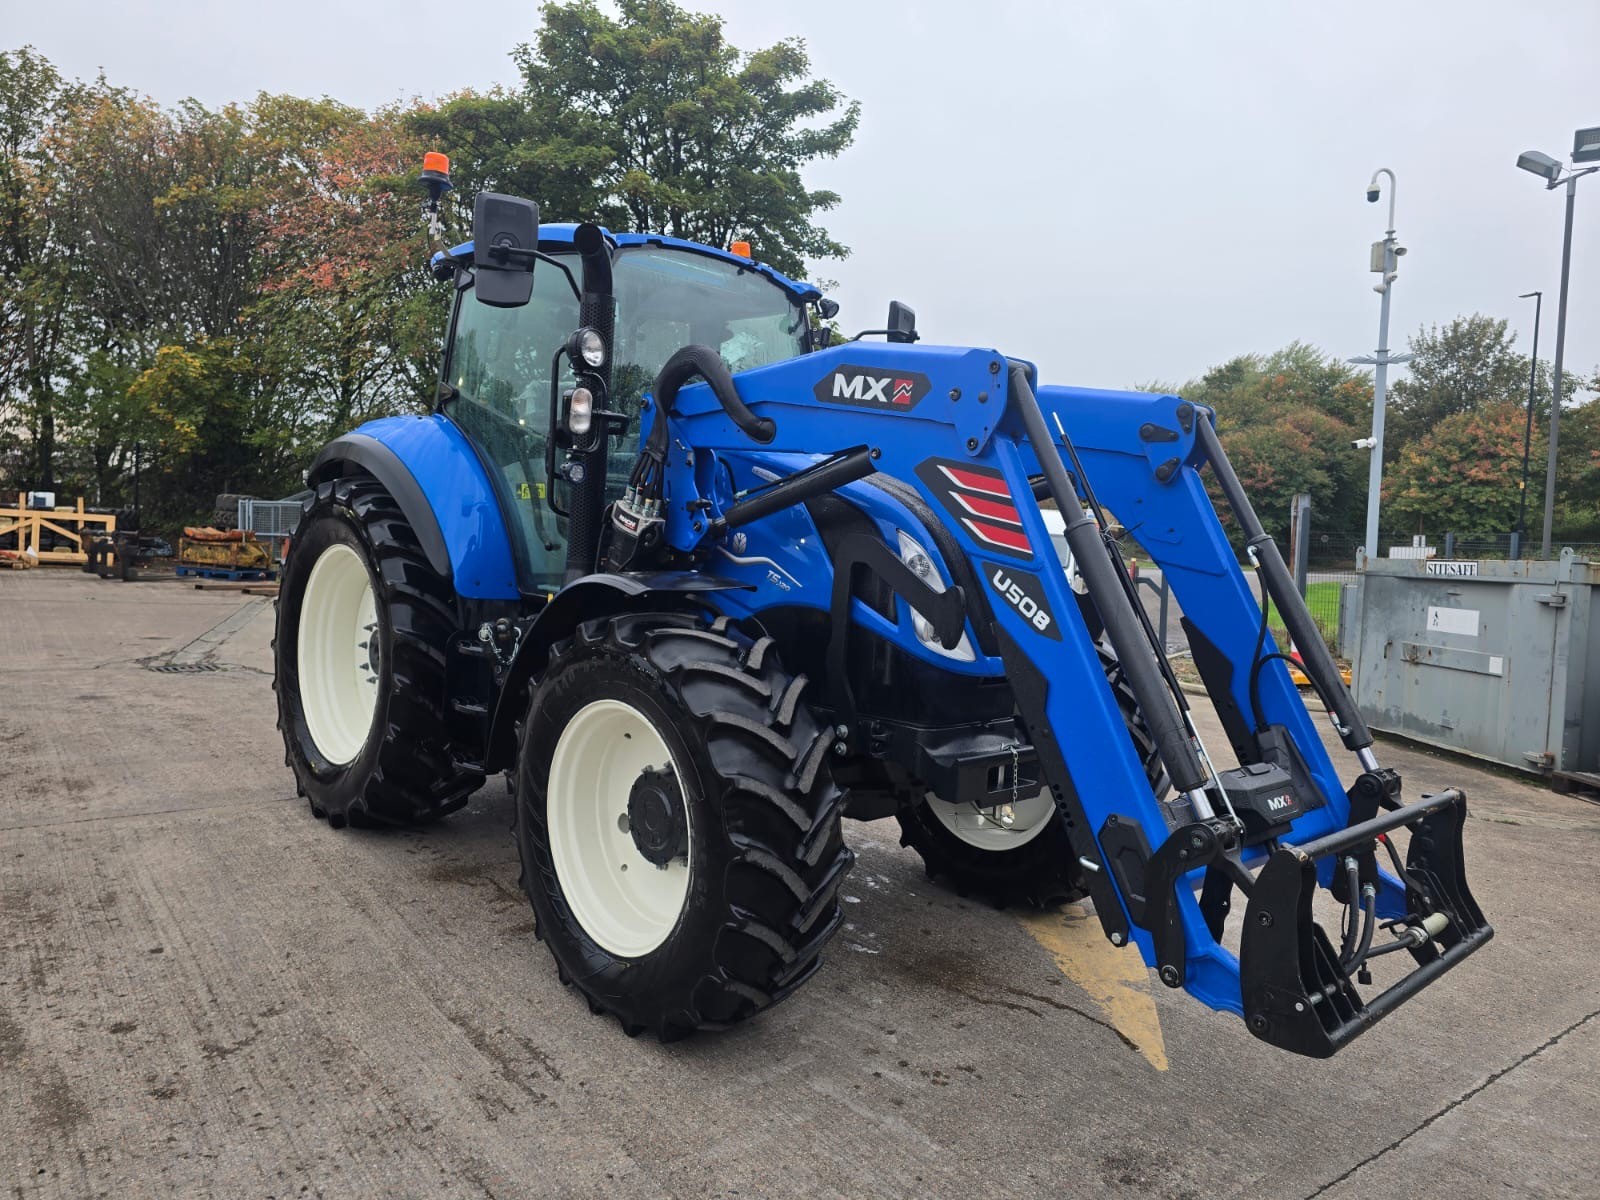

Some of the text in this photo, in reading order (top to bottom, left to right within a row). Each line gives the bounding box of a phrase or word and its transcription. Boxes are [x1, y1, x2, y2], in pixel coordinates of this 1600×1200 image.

[832, 373, 892, 403] MX
[993, 568, 1051, 631] U508
[1267, 795, 1288, 811] MX
